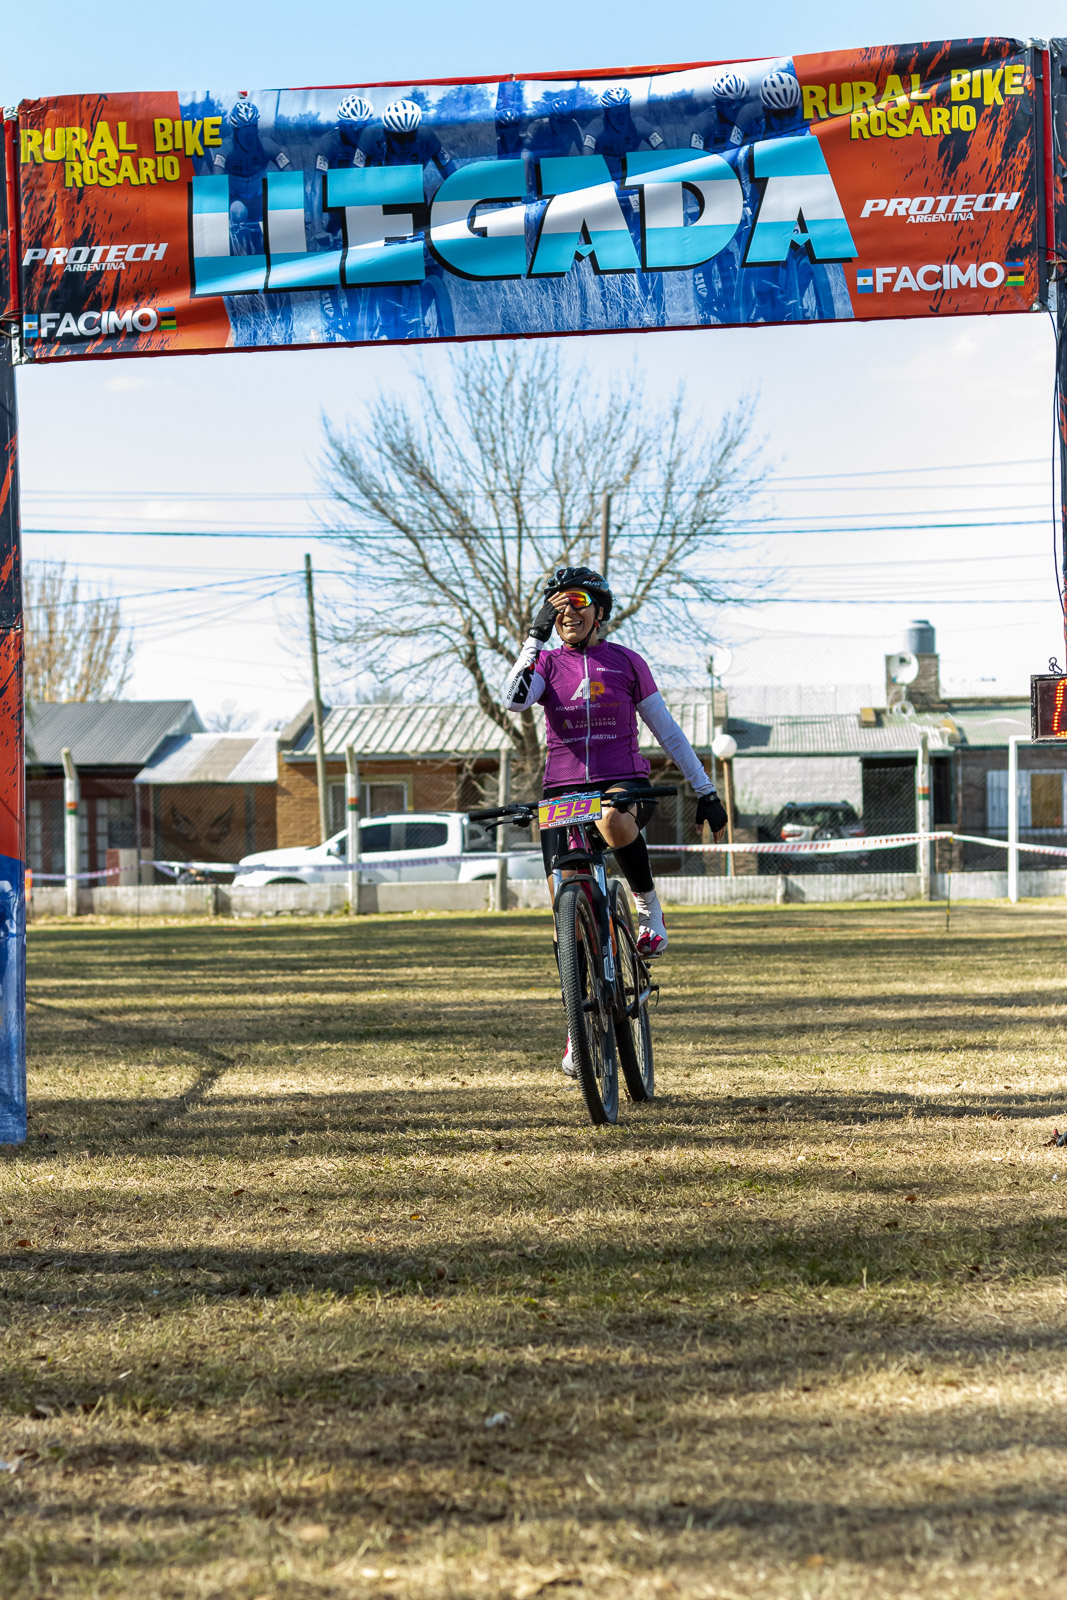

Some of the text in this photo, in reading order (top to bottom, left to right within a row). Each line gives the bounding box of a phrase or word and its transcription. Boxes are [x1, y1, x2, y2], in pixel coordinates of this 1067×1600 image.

[802, 64, 1025, 119] RURAL BIKE
[850, 105, 977, 139] ROSARIO
[20, 116, 222, 164] RURAL BIKE
[65, 155, 180, 188] ROSARIO
[189, 135, 858, 298] LLEGADA
[860, 192, 1021, 218] PROTECH
[906, 212, 975, 224] ARGENTINA
[22, 243, 169, 266] PROTECH
[63, 261, 126, 273] ARGENTINA
[876, 261, 1005, 293] FACIMO
[40, 307, 158, 338] FACIMO
[570, 678, 605, 701] AP
[547, 799, 593, 821] 139
